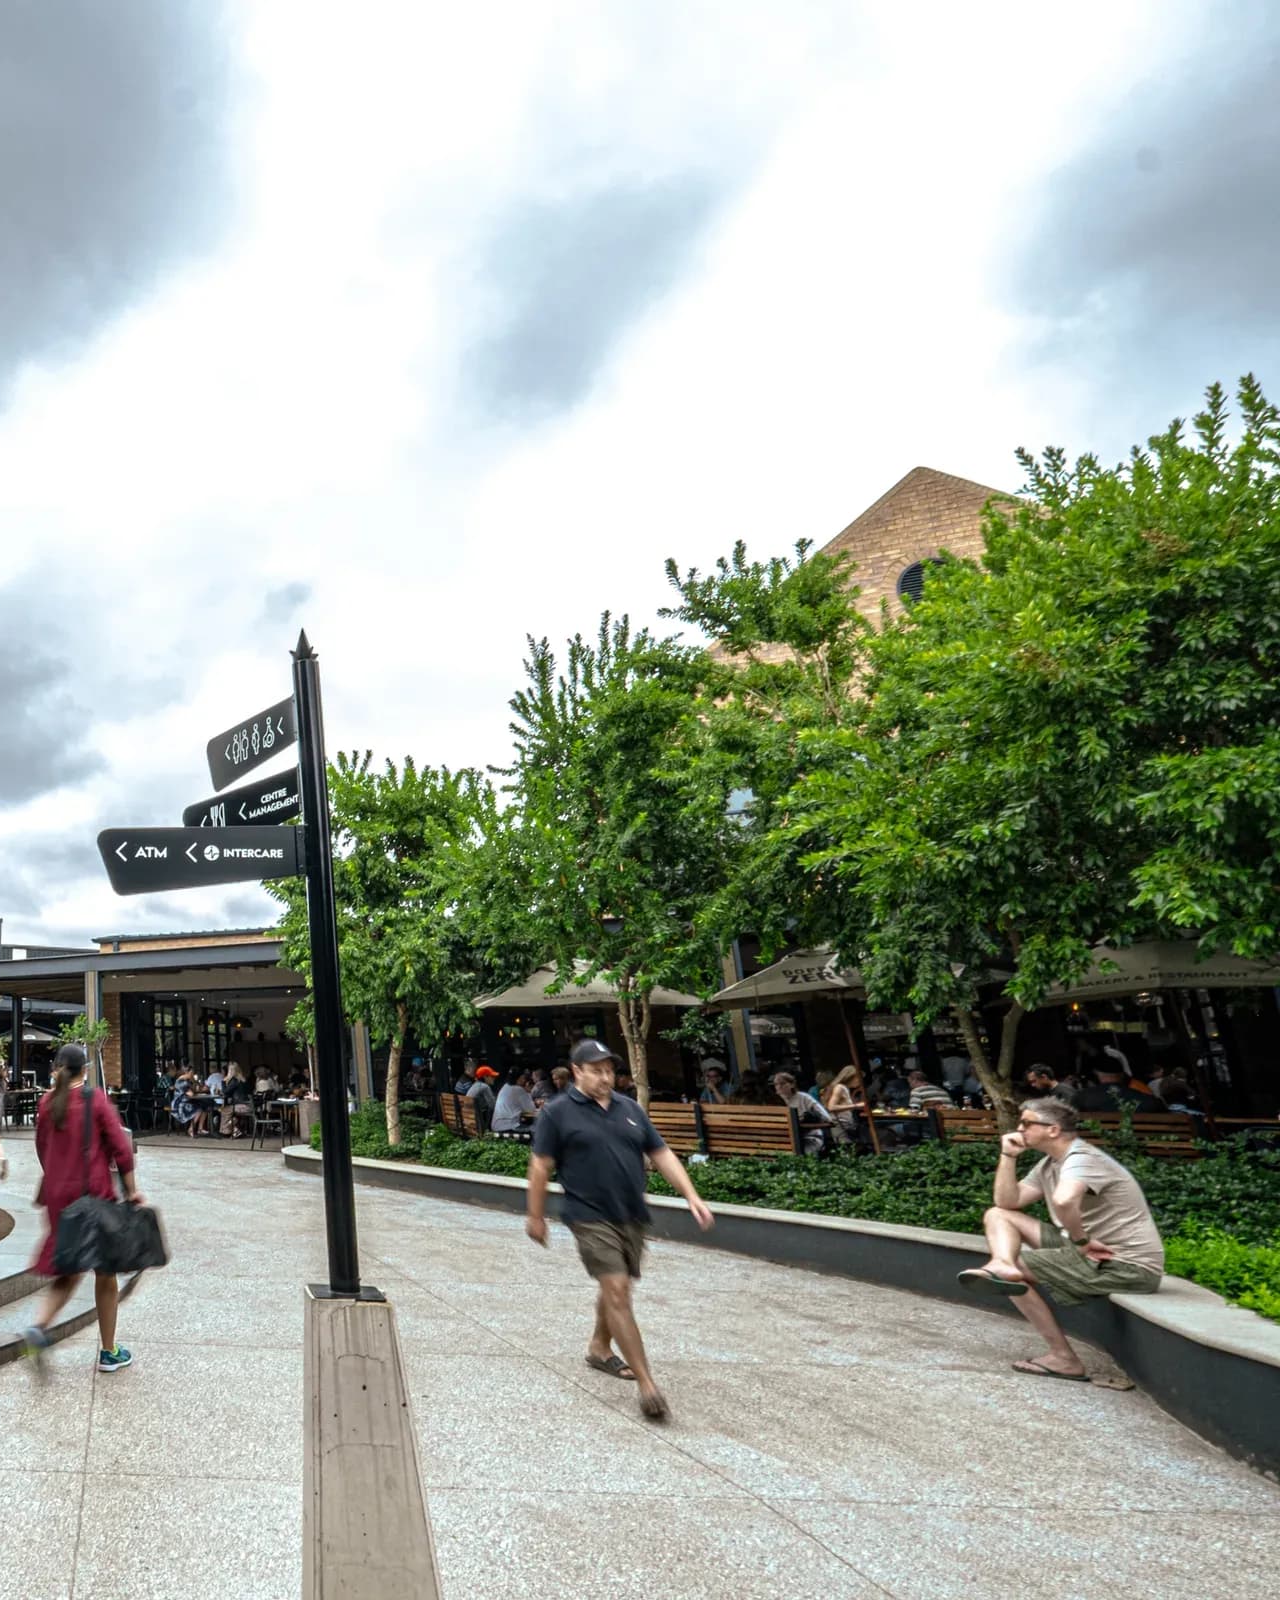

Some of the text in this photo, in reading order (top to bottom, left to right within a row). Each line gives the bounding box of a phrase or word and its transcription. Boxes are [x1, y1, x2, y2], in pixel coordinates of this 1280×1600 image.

[260, 787, 288, 804] CENTRE
[249, 794, 299, 819] MANAGEMENT
[134, 846, 168, 858] ATM
[223, 848, 284, 858] INTERCARE
